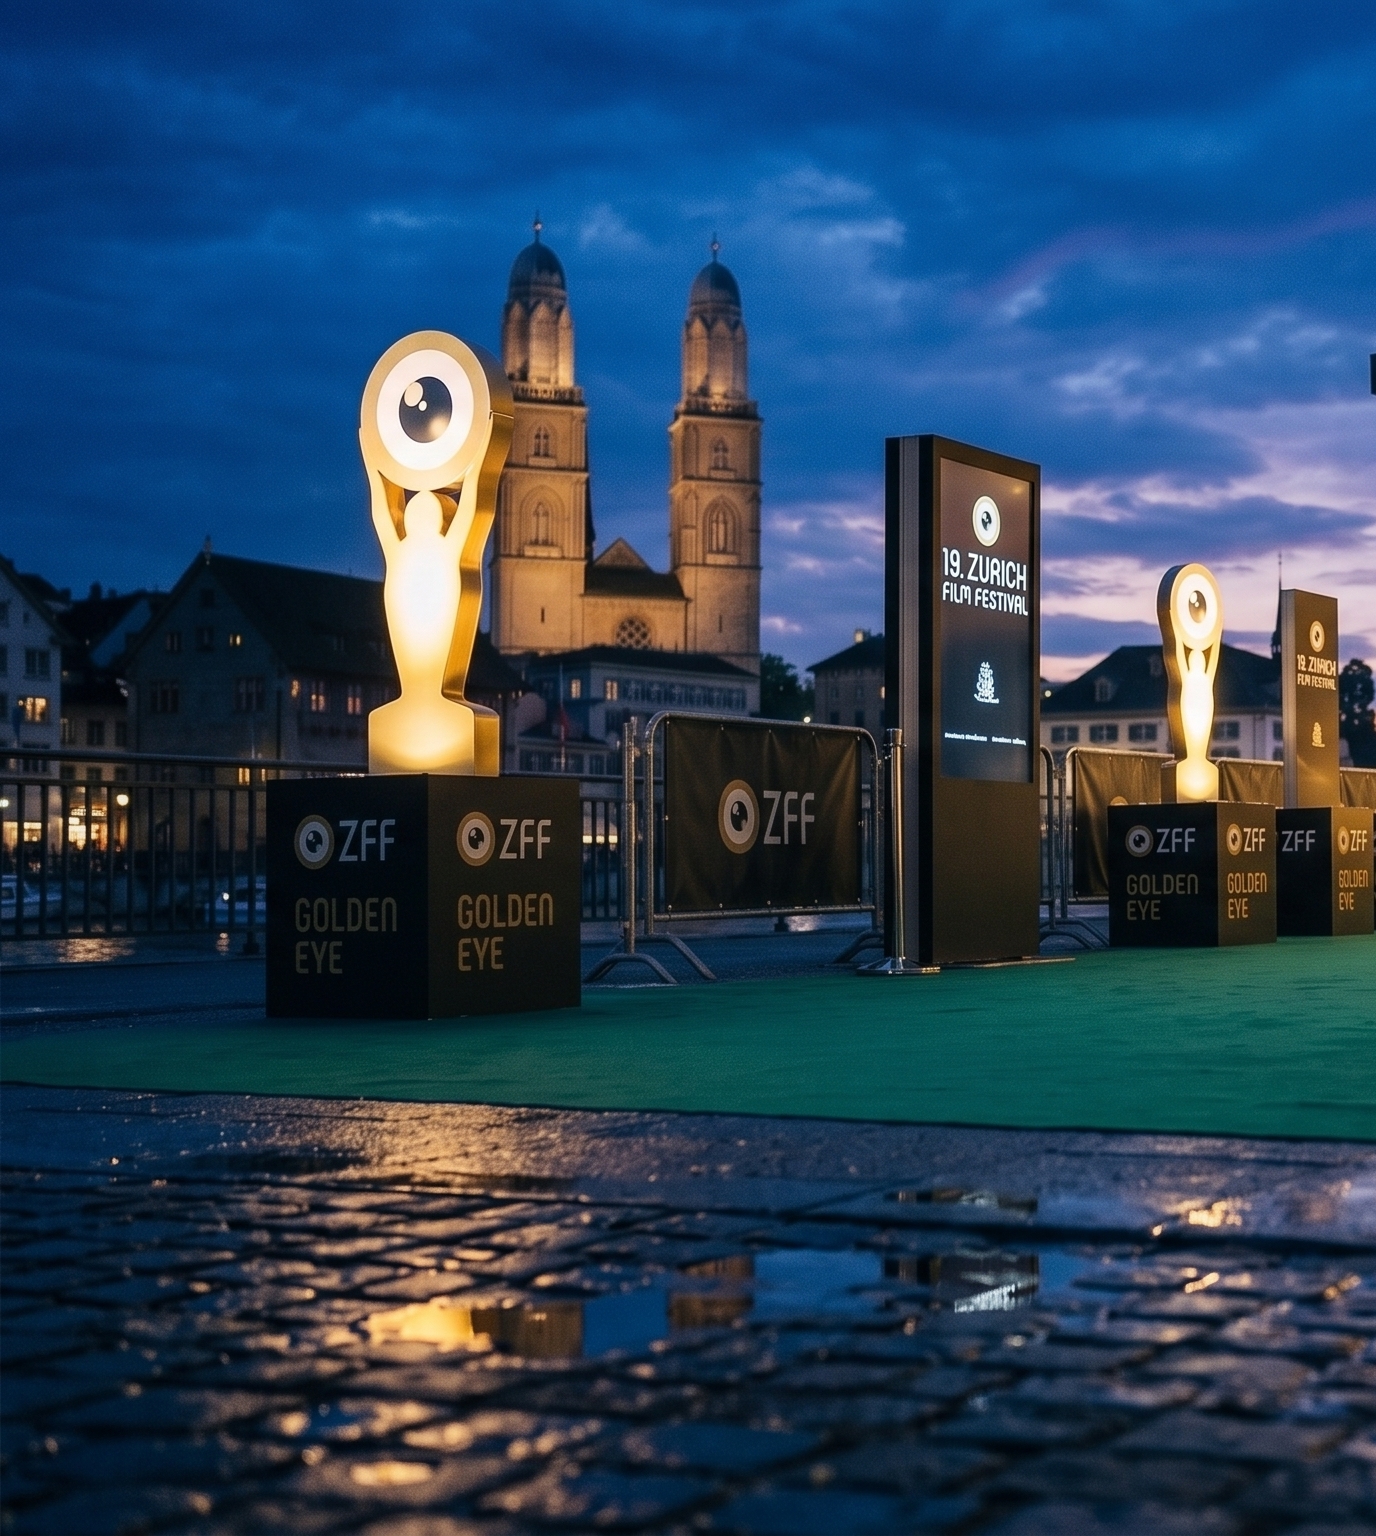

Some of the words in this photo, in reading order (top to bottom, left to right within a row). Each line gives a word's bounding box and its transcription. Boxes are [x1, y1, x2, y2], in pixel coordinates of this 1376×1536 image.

[942, 546, 964, 579] 19.
[967, 552, 1027, 592] ZURICH
[942, 581, 972, 606] FILM
[974, 587, 1029, 617] FESTIVAL
[763, 790, 815, 845] ZFF
[338, 818, 396, 862] ZFF
[499, 819, 552, 860] ZFF
[1156, 827, 1196, 854] ZFF
[1243, 827, 1266, 852] ZFF
[1281, 830, 1316, 852] ZFF
[1350, 830, 1368, 852] ZFF
[1126, 874, 1199, 896] GOLDEN
[1227, 872, 1268, 894] GOLDEN
[295, 897, 397, 932] GOLDEN
[457, 893, 554, 930] GOLDEN
[1127, 900, 1161, 920] EYE
[1228, 898, 1249, 919] EYE
[295, 941, 343, 974] EYE
[457, 936, 504, 972] EYE
